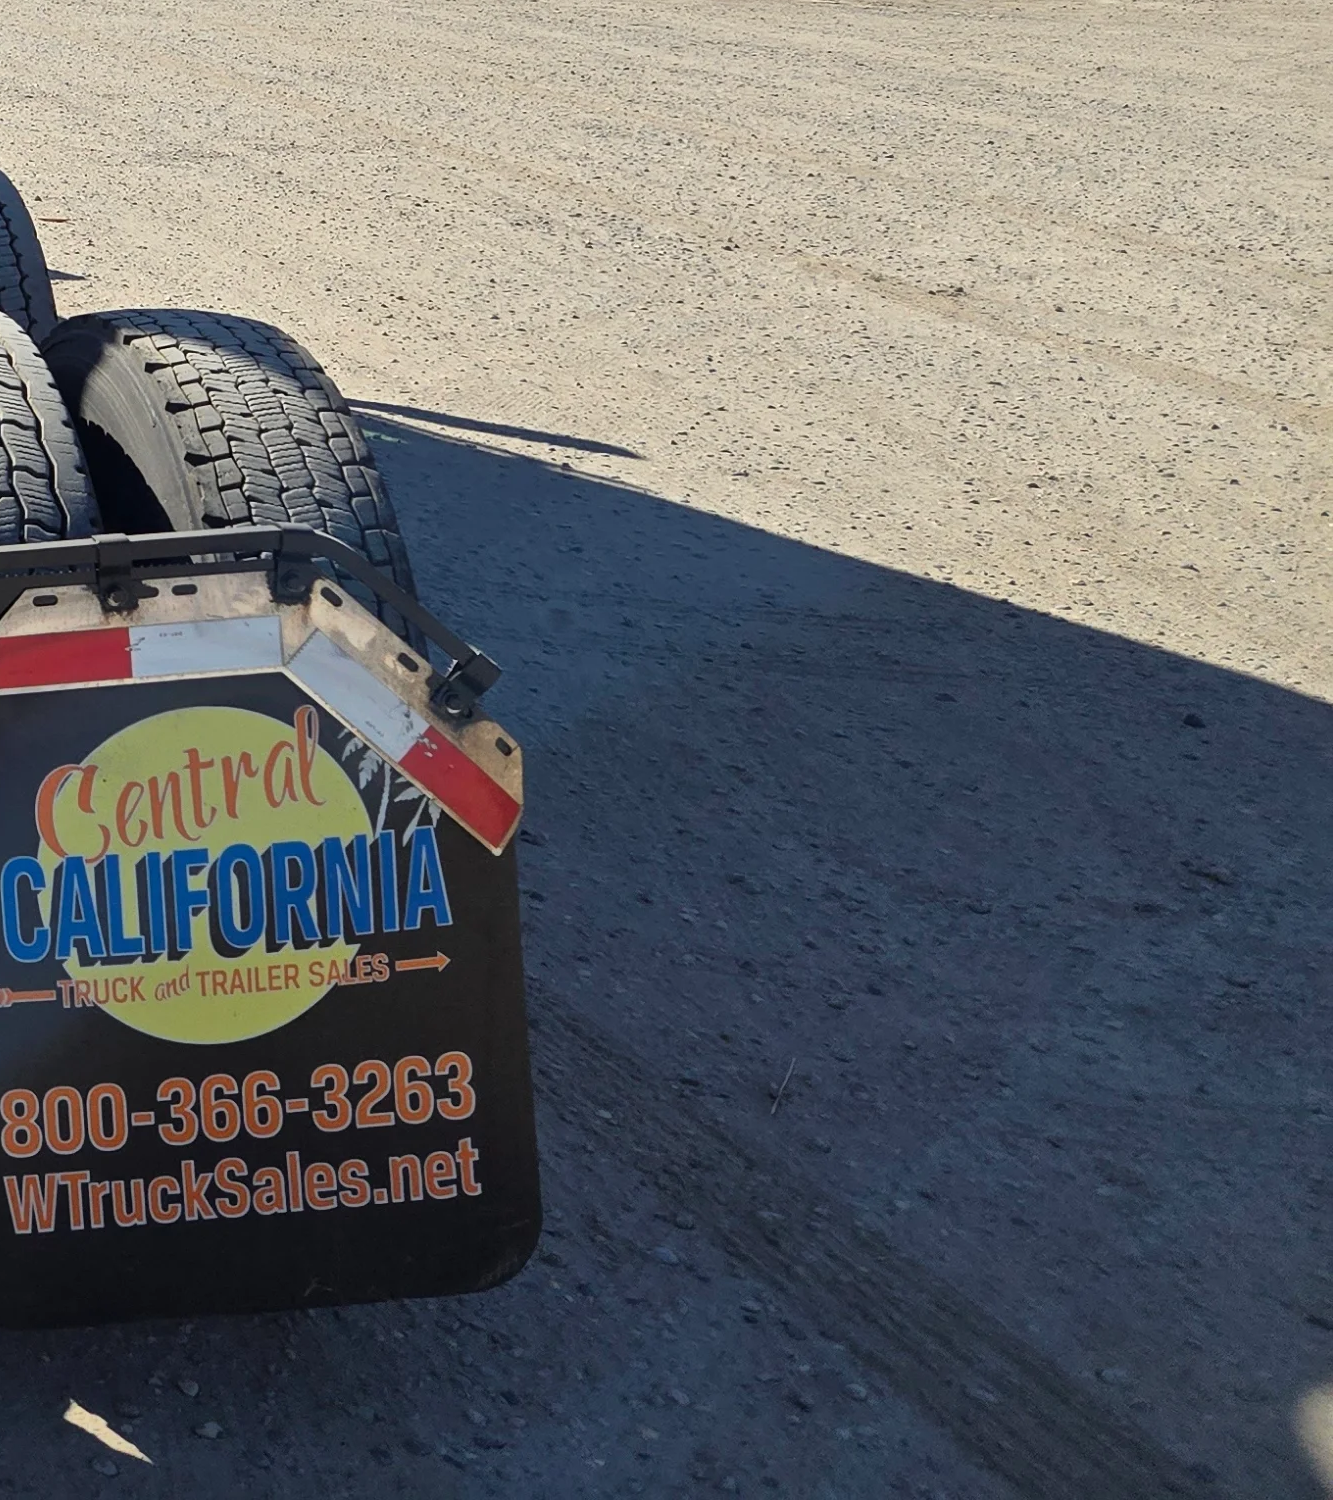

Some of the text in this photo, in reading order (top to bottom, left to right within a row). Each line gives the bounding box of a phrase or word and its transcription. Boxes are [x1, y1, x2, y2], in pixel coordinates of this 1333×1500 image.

[35, 704, 327, 867] Central
[0, 824, 454, 964] CALIFORNIA
[56, 951, 391, 1009] TRUCK and TRAILER SALES
[2, 1136, 483, 1236] WTruckSales.net
